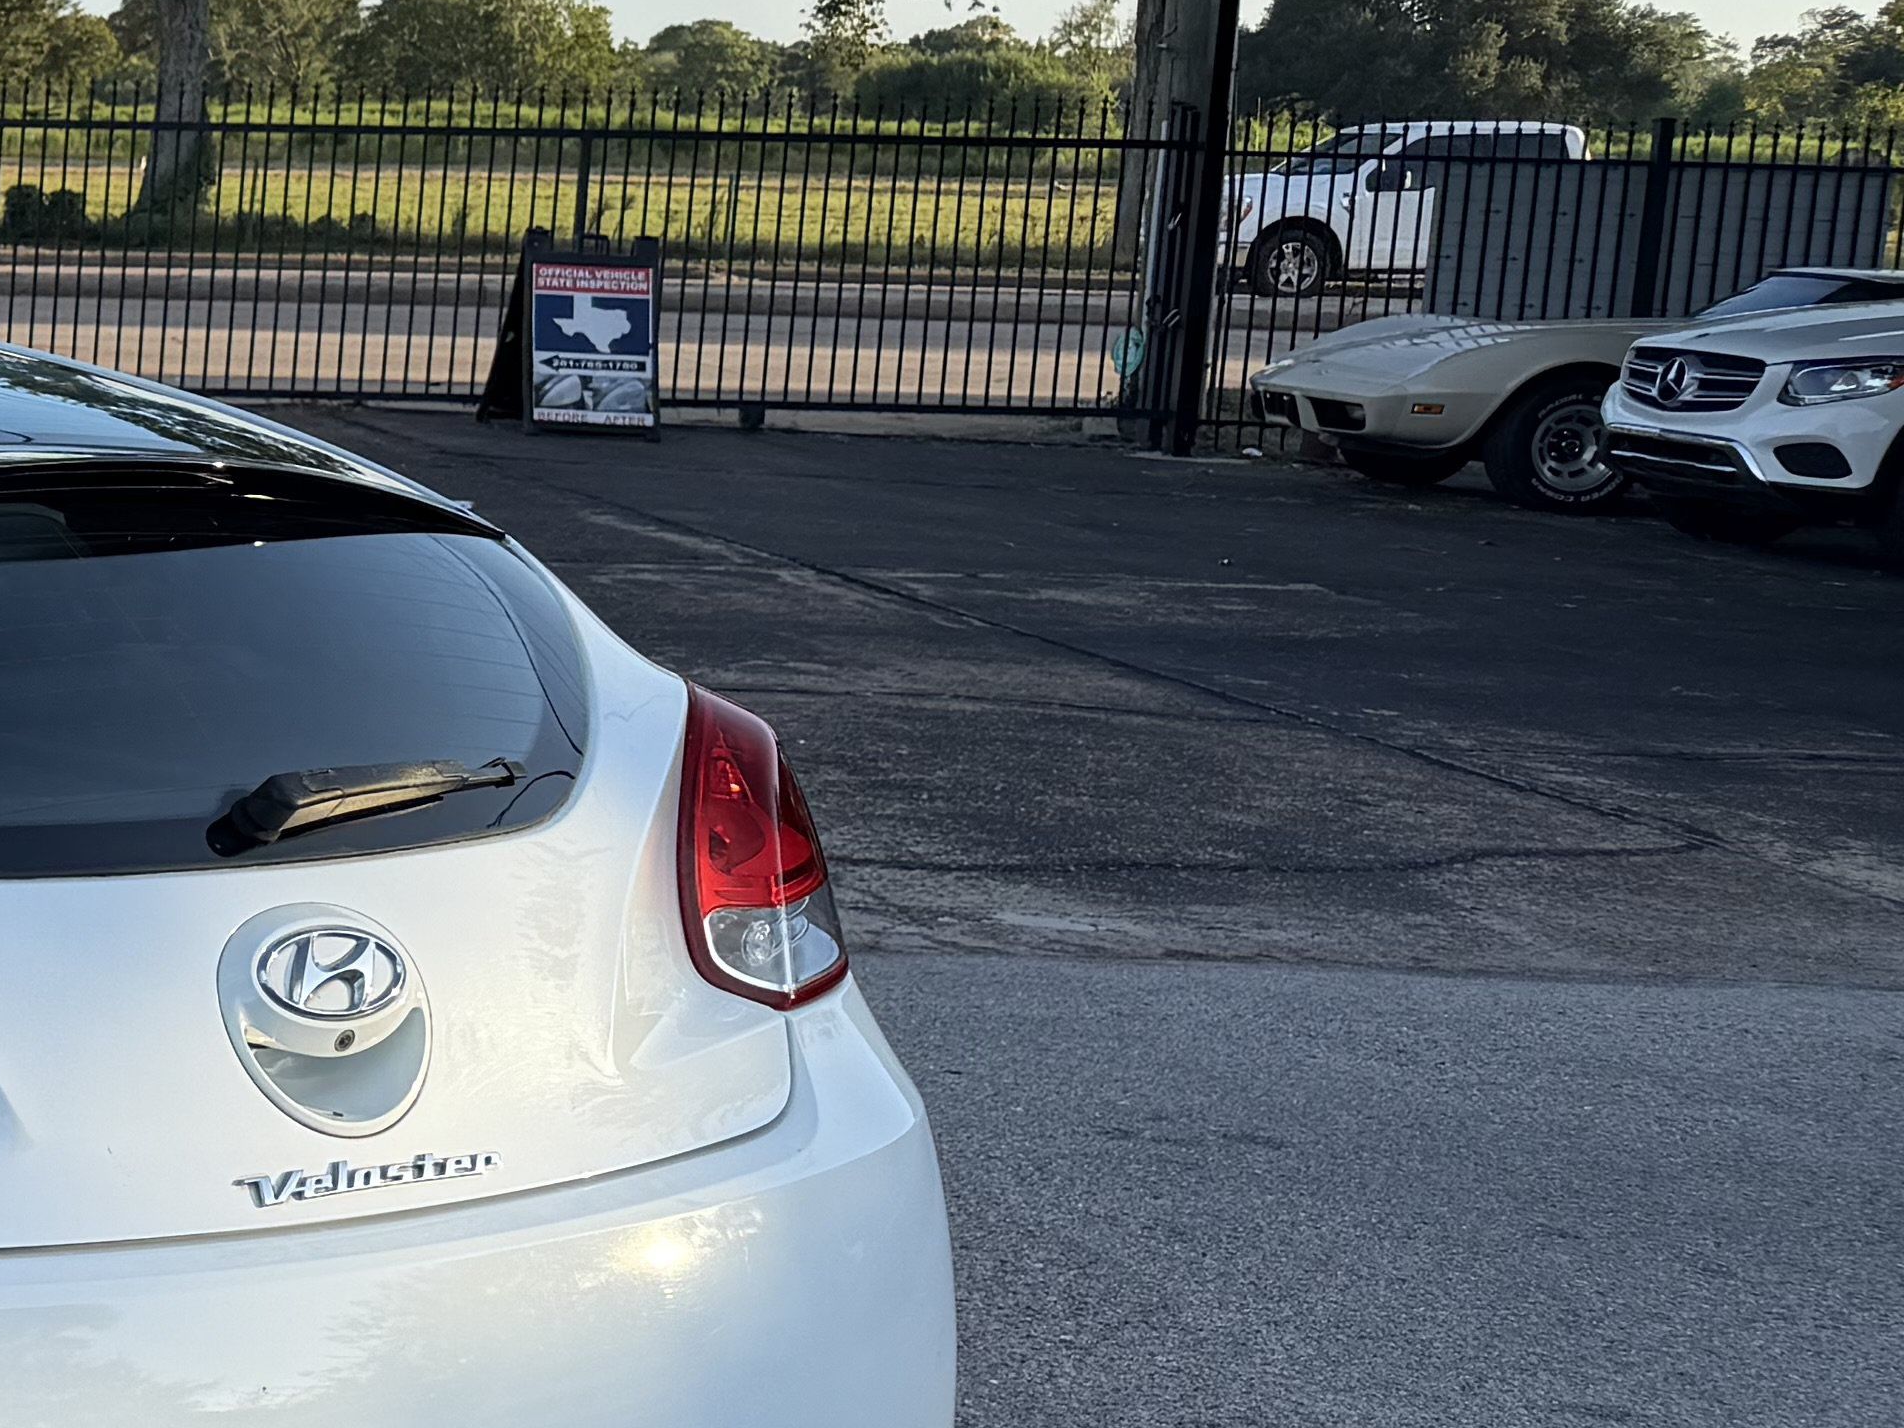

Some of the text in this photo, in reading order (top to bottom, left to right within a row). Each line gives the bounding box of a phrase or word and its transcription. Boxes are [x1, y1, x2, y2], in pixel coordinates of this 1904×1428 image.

[538, 266, 646, 281] OFFICIAL VEHICLE
[537, 277, 648, 292] STATE INSPECTION
[536, 411, 646, 427] BEFORE AFTER
[231, 1150, 505, 1209] Veloster
